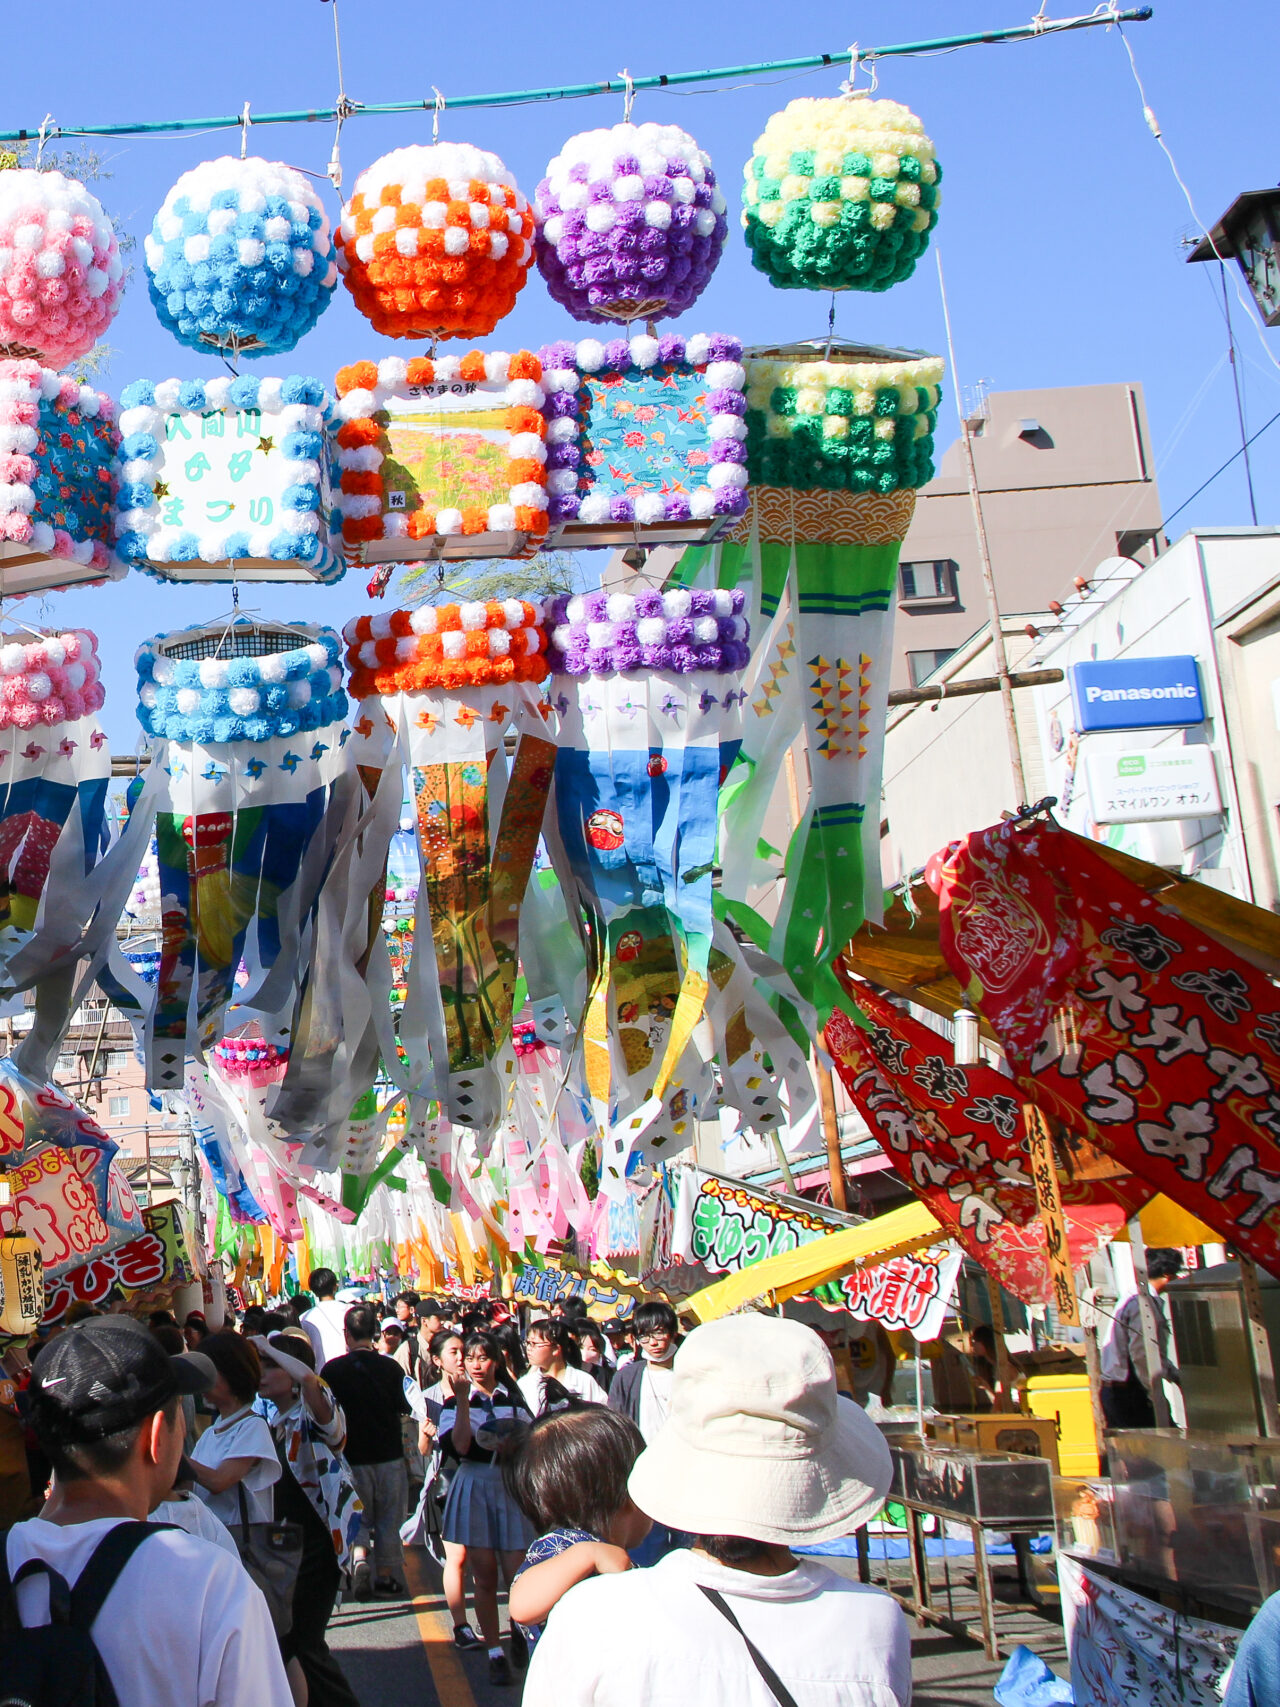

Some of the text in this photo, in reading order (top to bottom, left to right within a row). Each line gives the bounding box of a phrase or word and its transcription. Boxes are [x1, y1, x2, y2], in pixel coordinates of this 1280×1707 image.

[390, 493, 404, 507] 秋
[162, 496, 274, 527] まつり
[1085, 683, 1197, 703] Panasonic
[1107, 791, 1211, 811] スマイルワン オカノ
[693, 1195, 798, 1268] きゅうり
